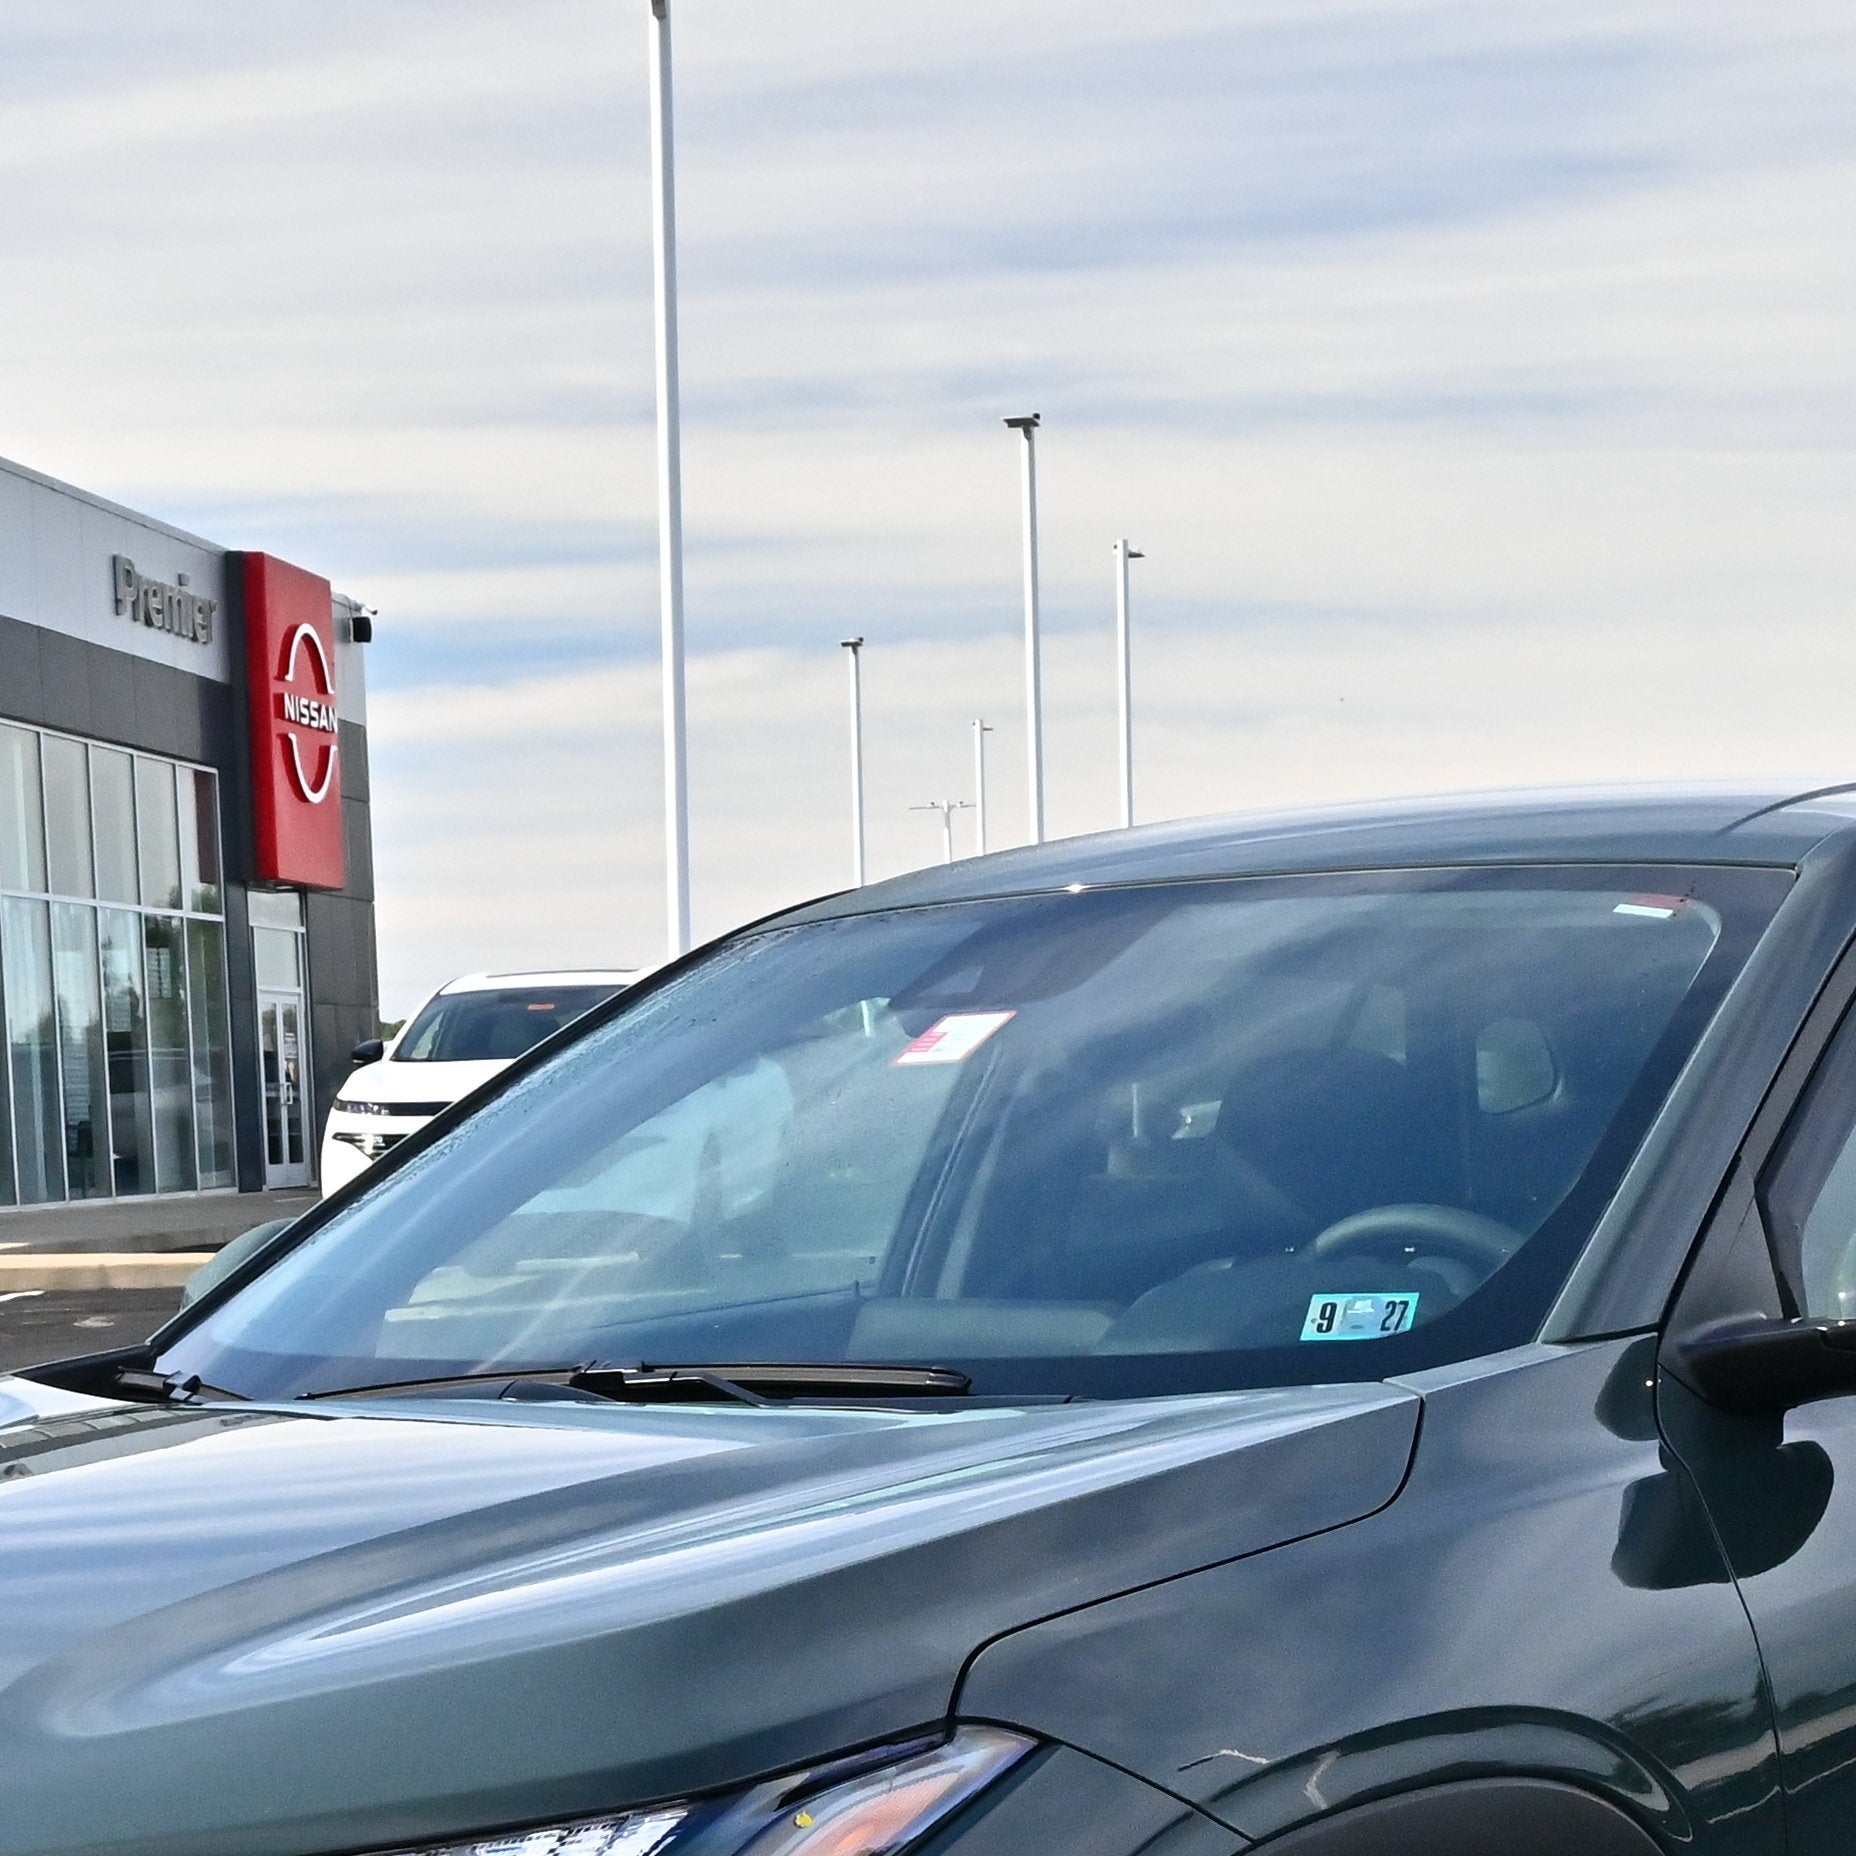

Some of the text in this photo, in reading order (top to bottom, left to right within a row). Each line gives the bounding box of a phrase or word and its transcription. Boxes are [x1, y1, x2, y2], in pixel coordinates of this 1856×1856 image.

[111, 554, 217, 644] Premier
[284, 691, 338, 734] NISSAN
[1316, 1300, 1410, 1334] 9 27
